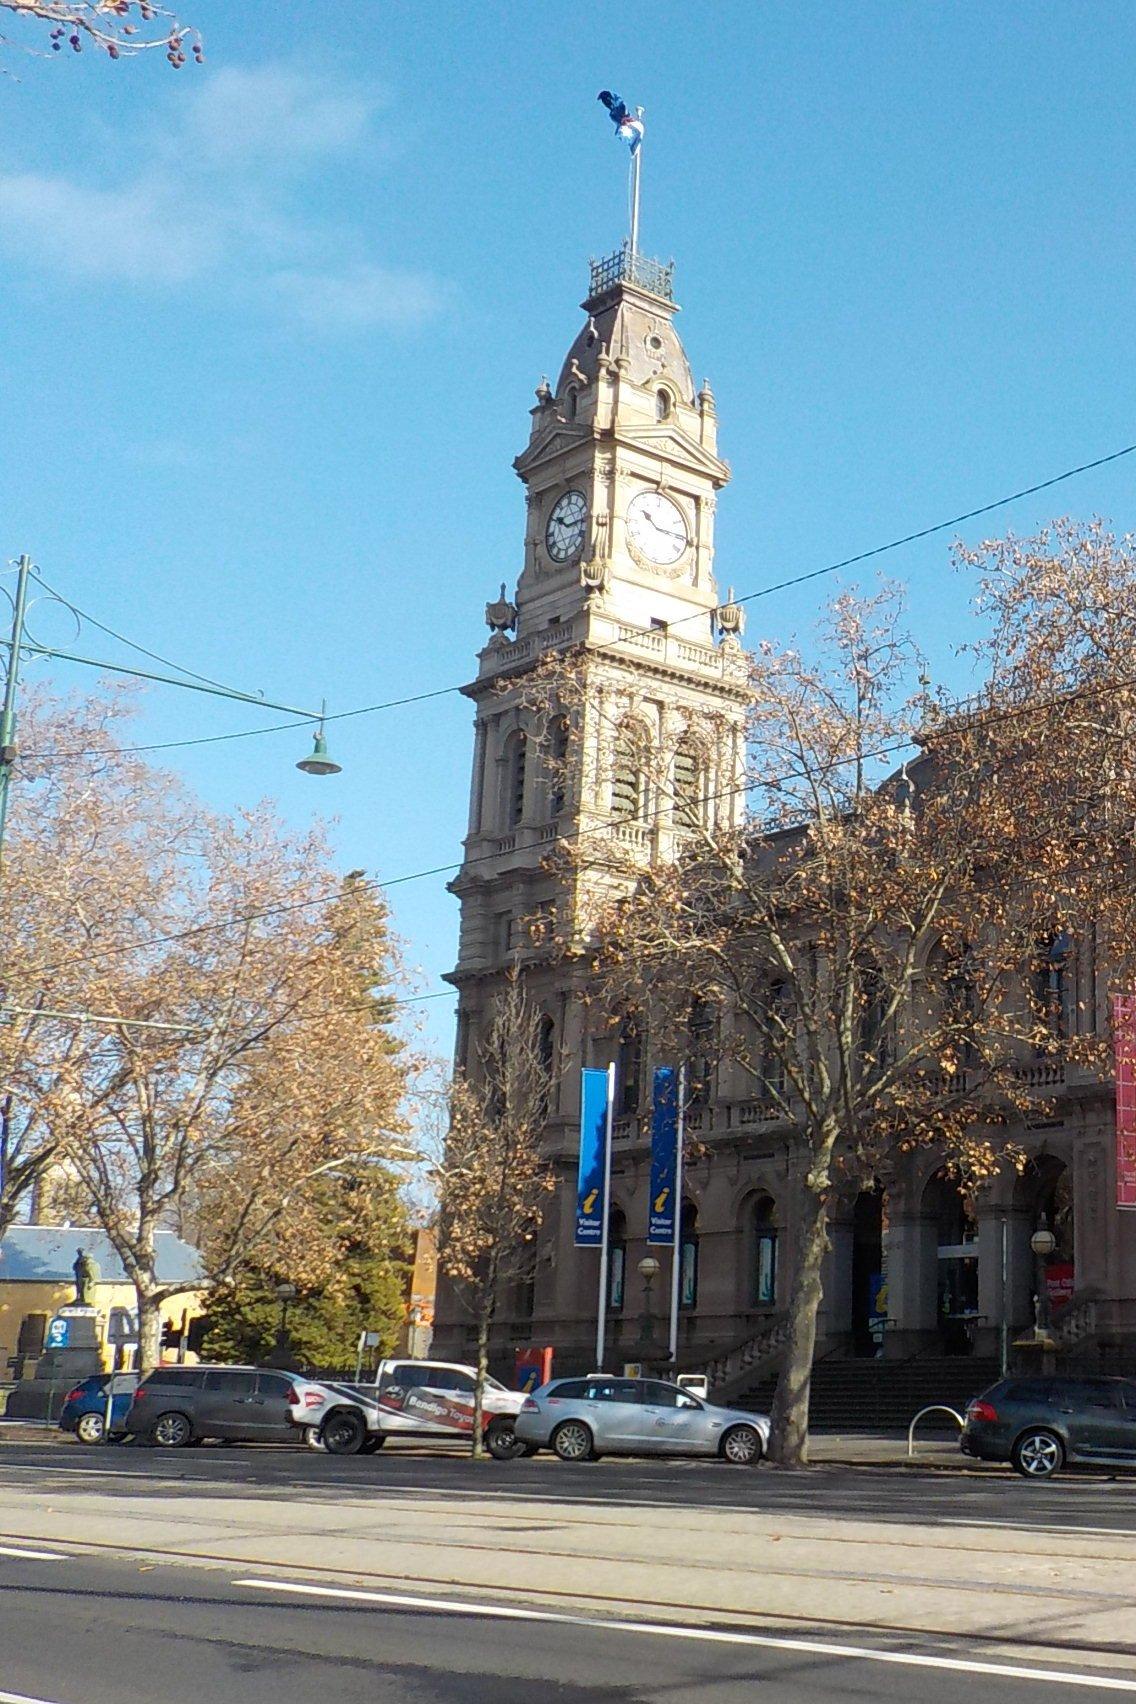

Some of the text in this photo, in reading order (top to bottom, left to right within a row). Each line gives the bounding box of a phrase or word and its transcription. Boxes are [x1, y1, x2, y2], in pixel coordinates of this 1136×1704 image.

[579, 1218, 601, 1226] Visitor
[651, 1217, 672, 1225] Visitor
[577, 1227, 601, 1236] Centre
[650, 1226, 673, 1234] Centre
[409, 1396, 475, 1423] Bendigo Toyot
